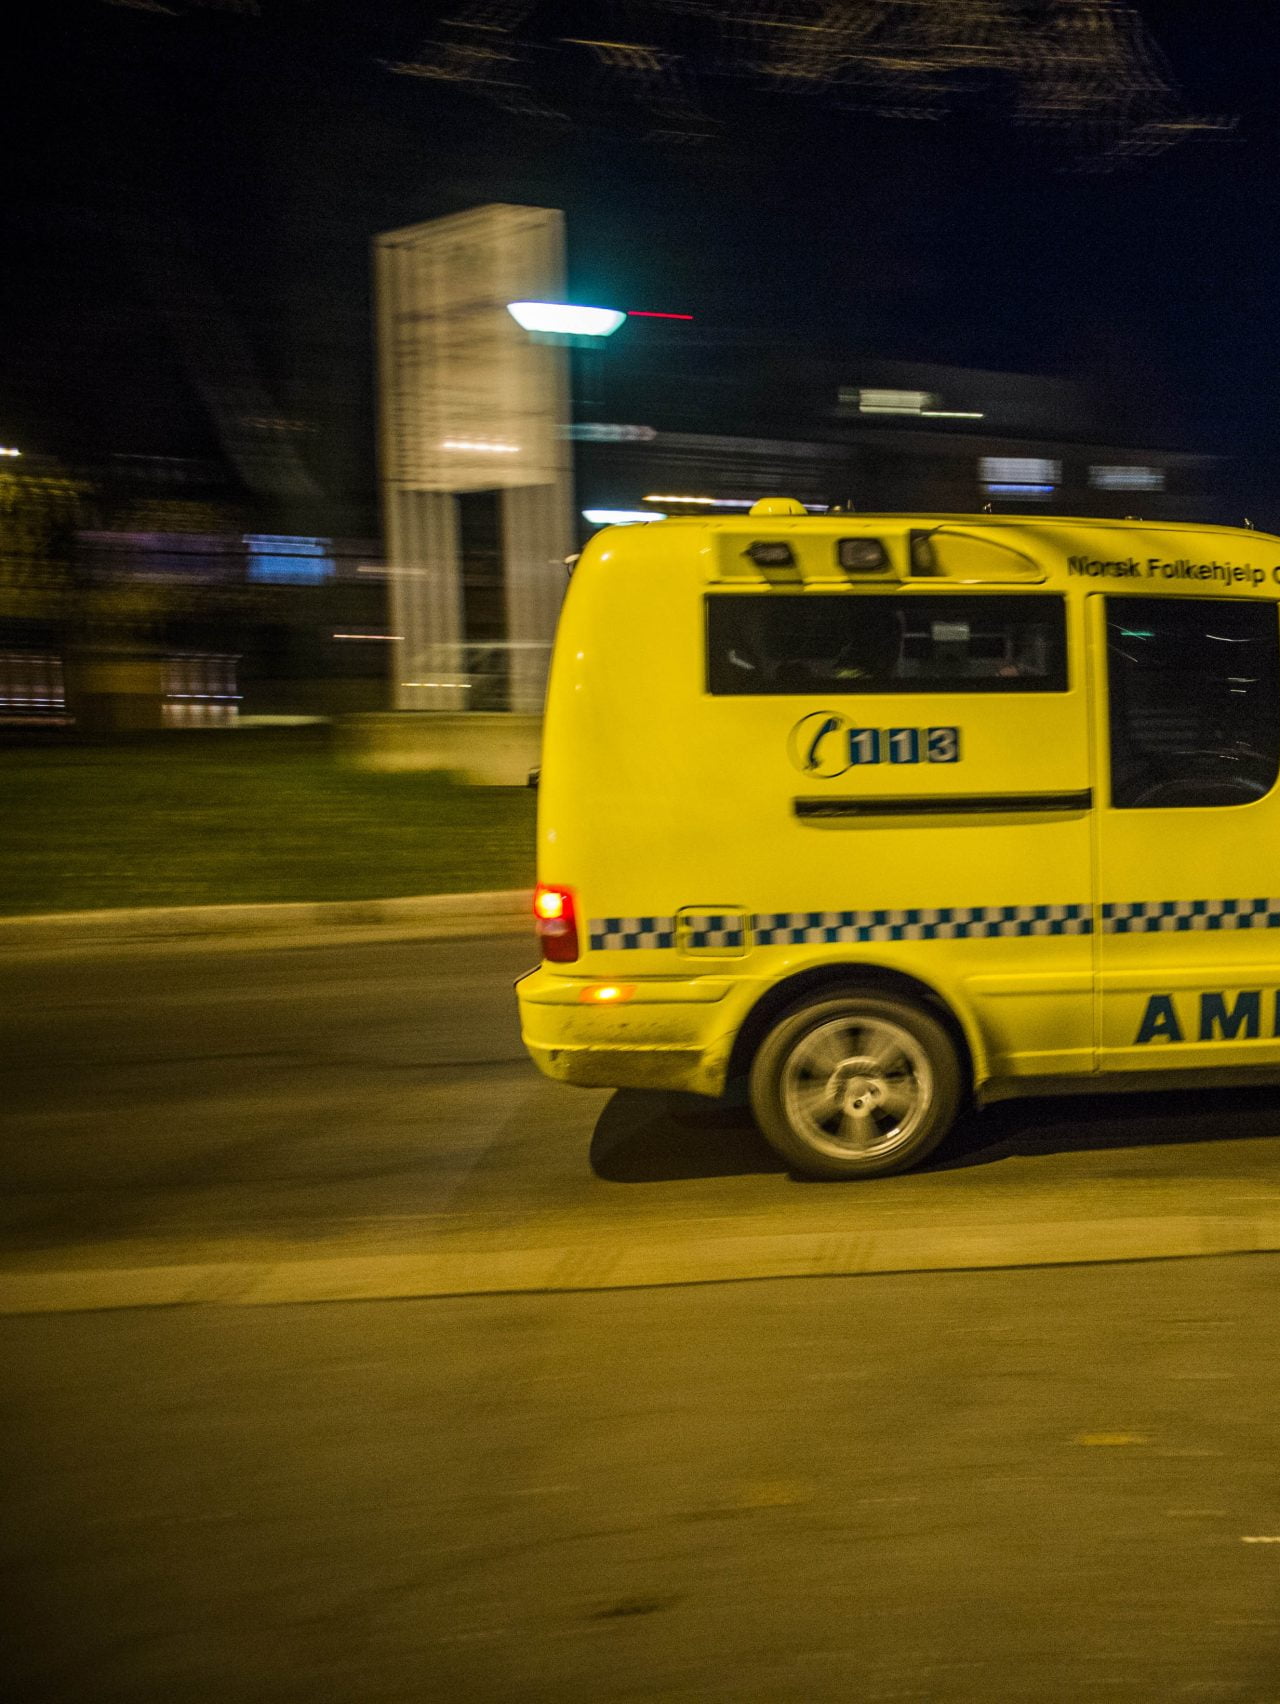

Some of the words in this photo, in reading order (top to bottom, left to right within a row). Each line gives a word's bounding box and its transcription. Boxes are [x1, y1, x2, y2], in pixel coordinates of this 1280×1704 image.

[1067, 556, 1141, 577] Norsk
[1148, 559, 1265, 587] Folkehjelp
[850, 729, 957, 762] 113
